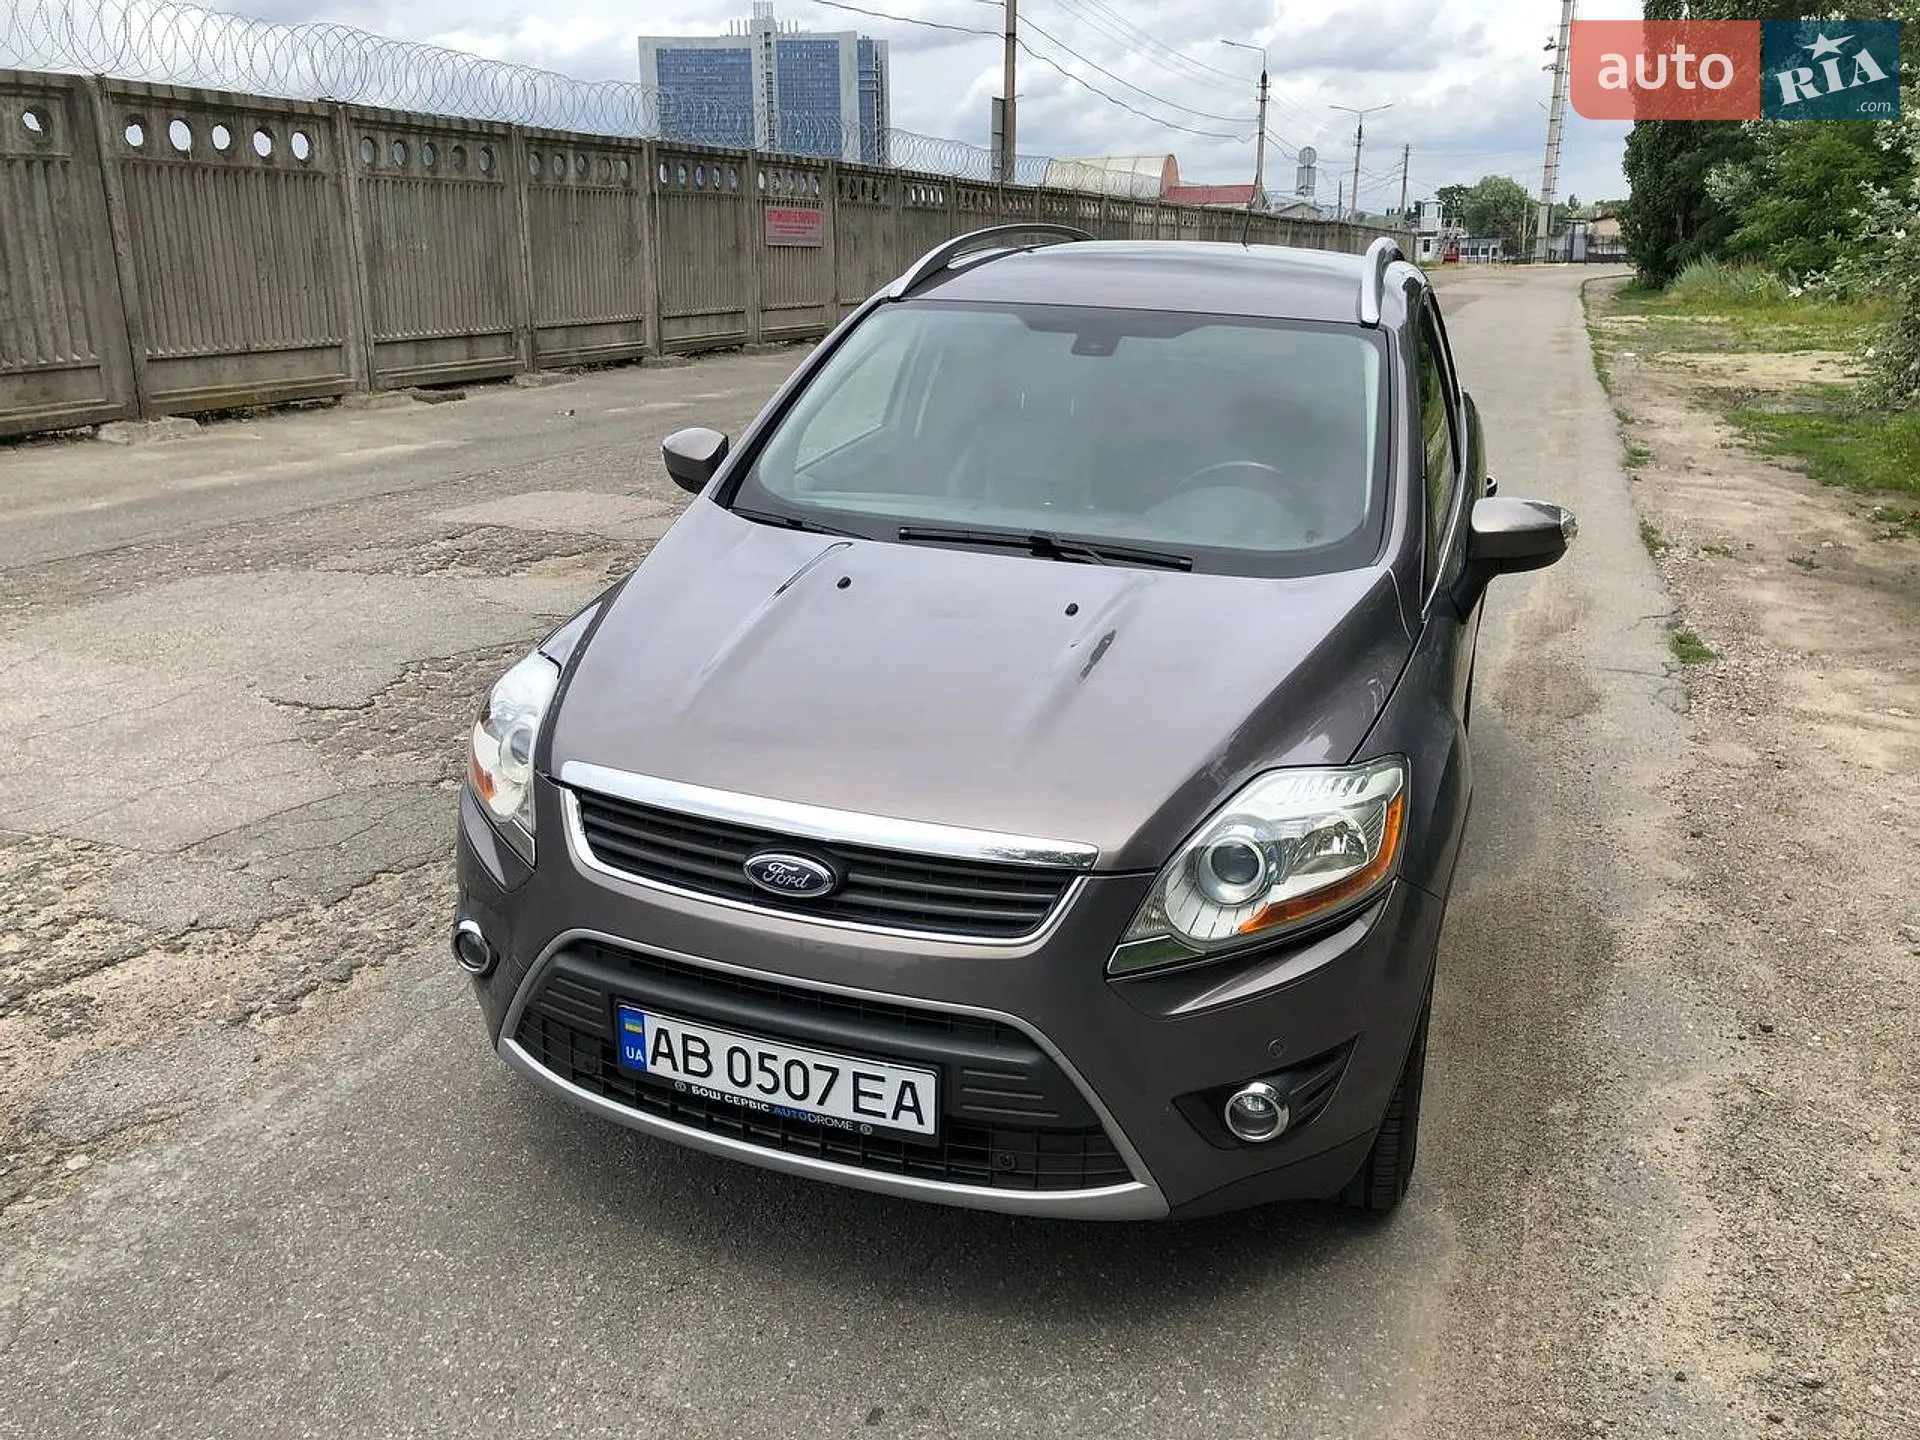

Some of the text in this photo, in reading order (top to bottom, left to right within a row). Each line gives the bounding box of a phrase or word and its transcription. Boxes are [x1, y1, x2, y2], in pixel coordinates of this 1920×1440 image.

[763, 862, 811, 889] Ford
[625, 1045, 645, 1063] UA
[650, 1027, 925, 1126] AB 0507 EA
[691, 1084, 854, 1131] БОШ СЕРВІС AUTODROME
